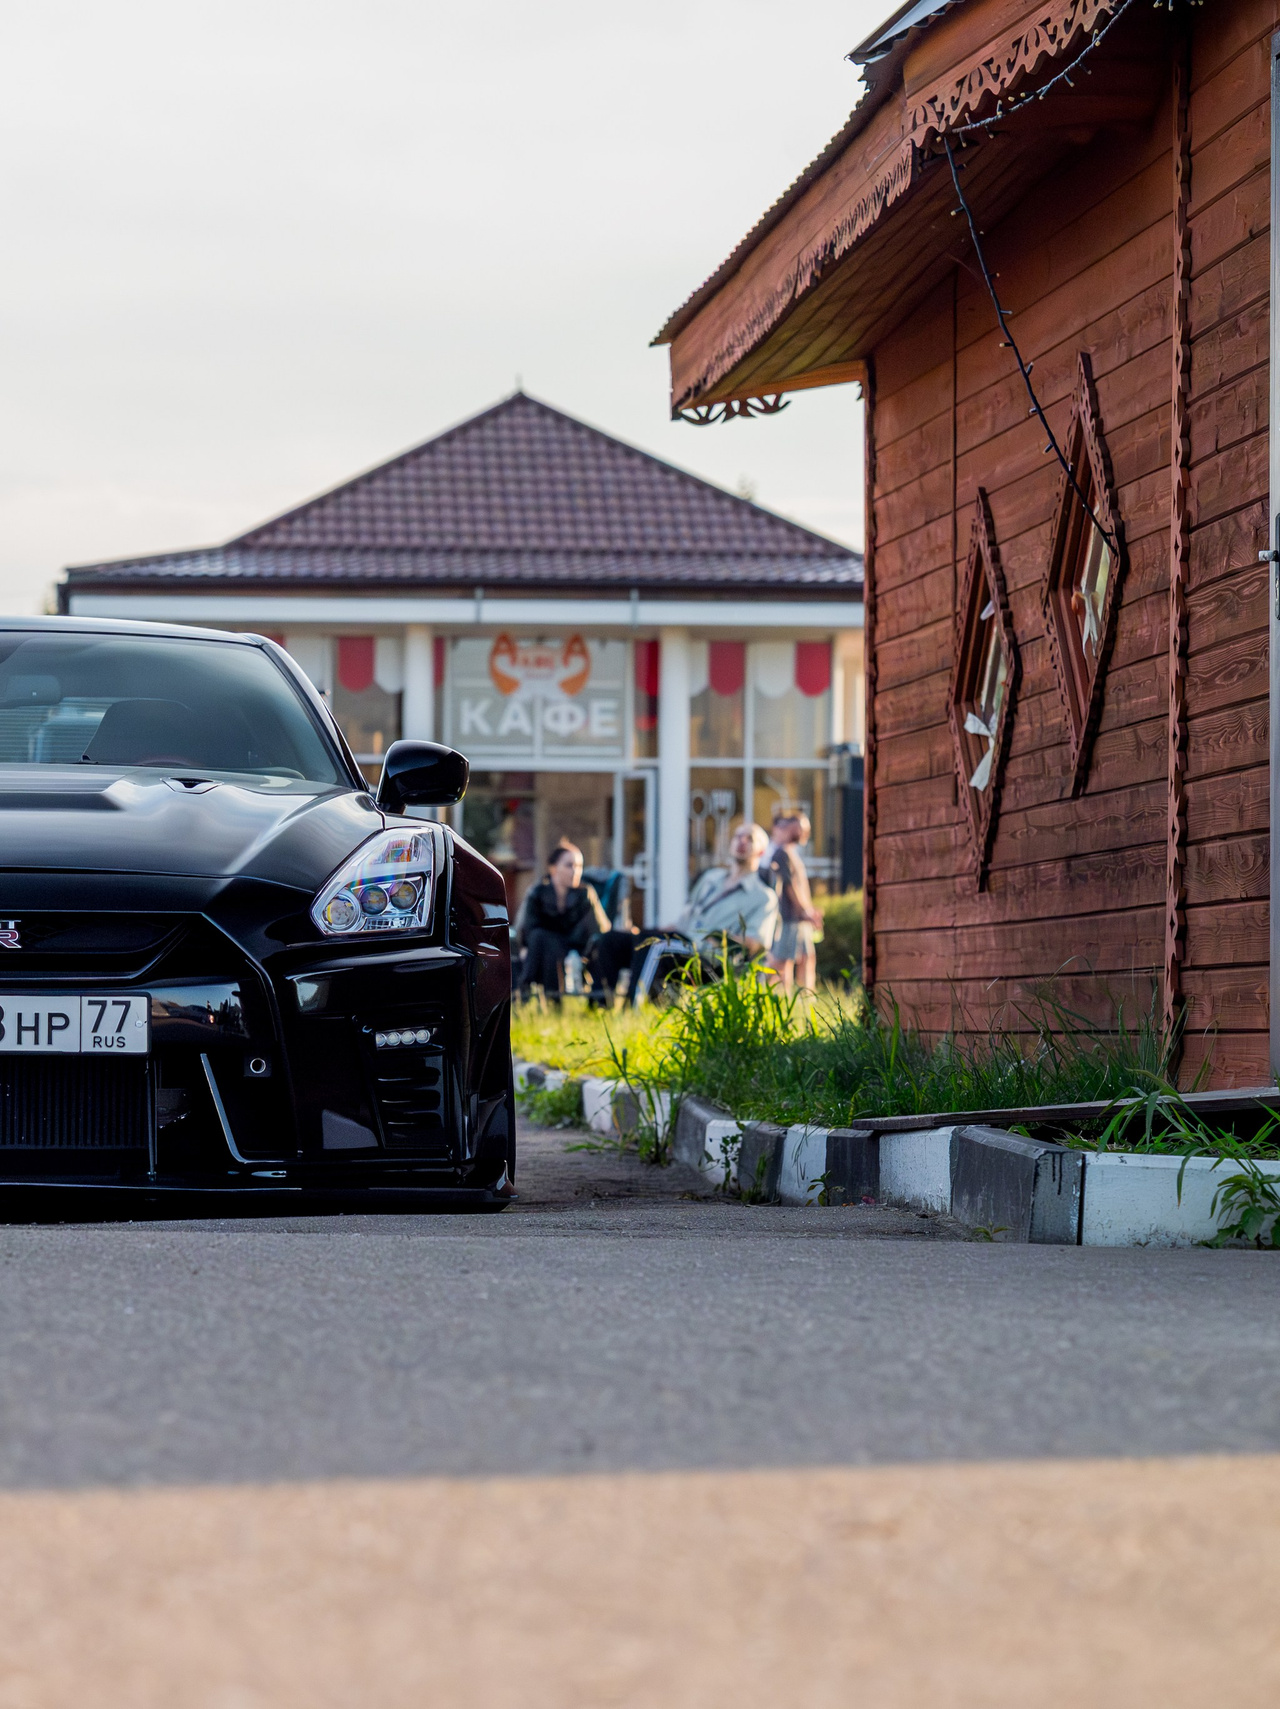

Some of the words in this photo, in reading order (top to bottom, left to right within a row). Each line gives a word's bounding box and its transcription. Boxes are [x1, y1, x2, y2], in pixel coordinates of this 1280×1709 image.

[459, 699, 619, 737] КАФЕ
[87, 1000, 132, 1034] 77
[93, 1035, 126, 1048] RUS
